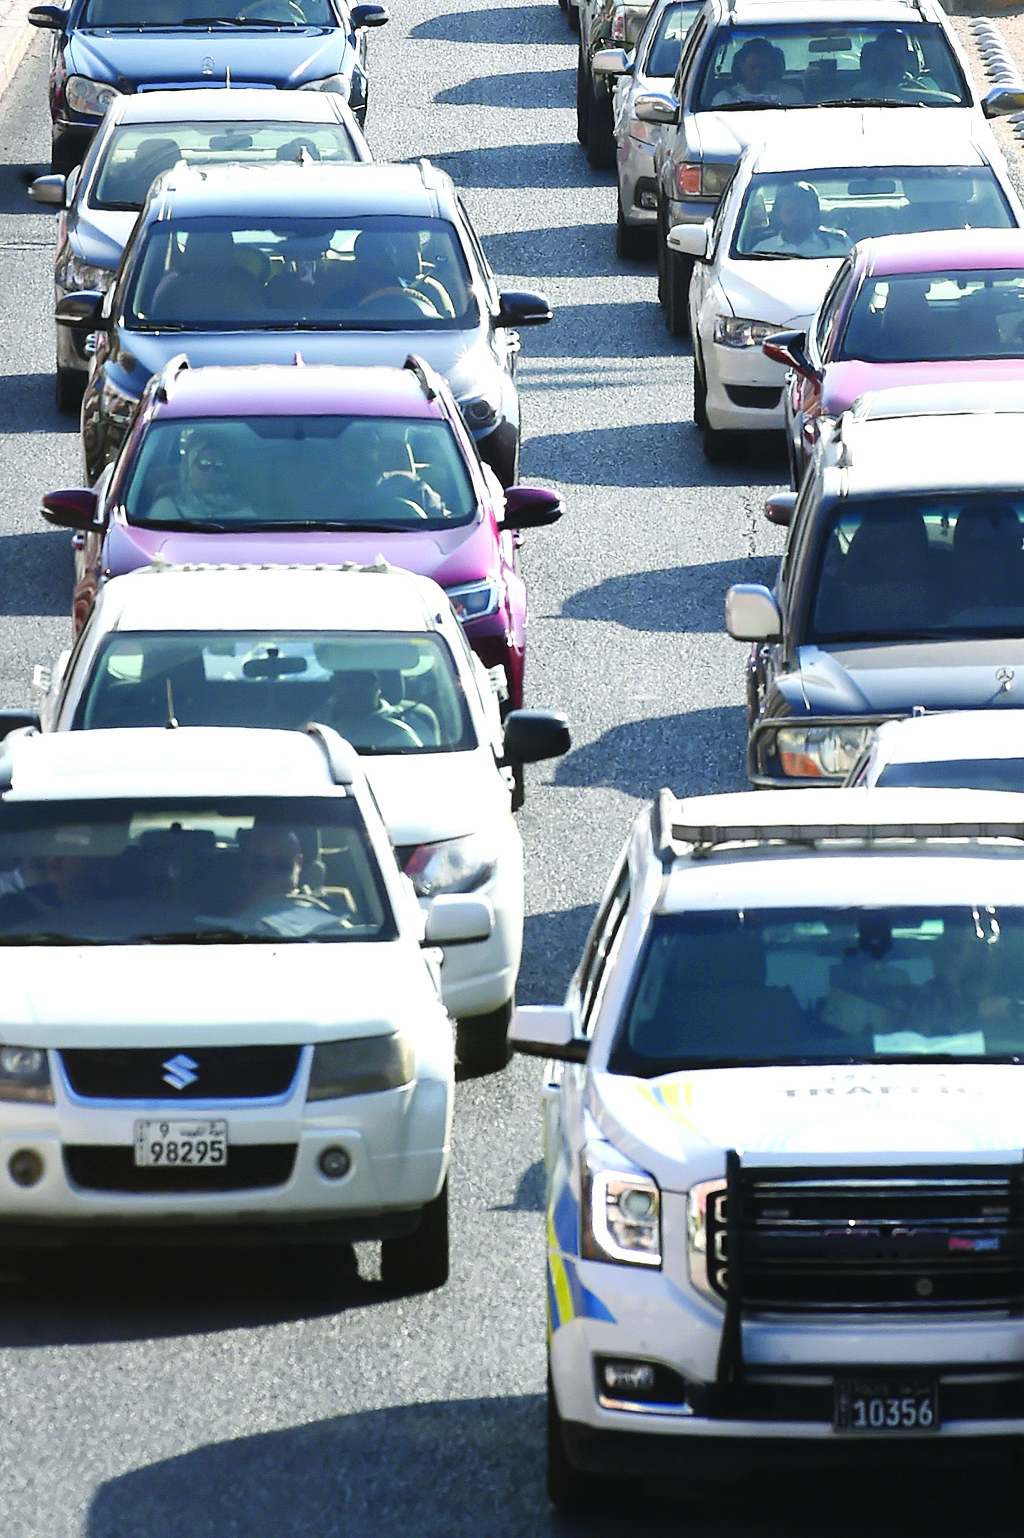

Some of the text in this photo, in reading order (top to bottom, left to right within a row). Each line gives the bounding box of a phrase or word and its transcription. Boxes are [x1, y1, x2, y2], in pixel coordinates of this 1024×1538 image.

[159, 1122, 169, 1139] 9
[151, 1141, 223, 1162] 98295
[853, 1398, 933, 1427] 10356
